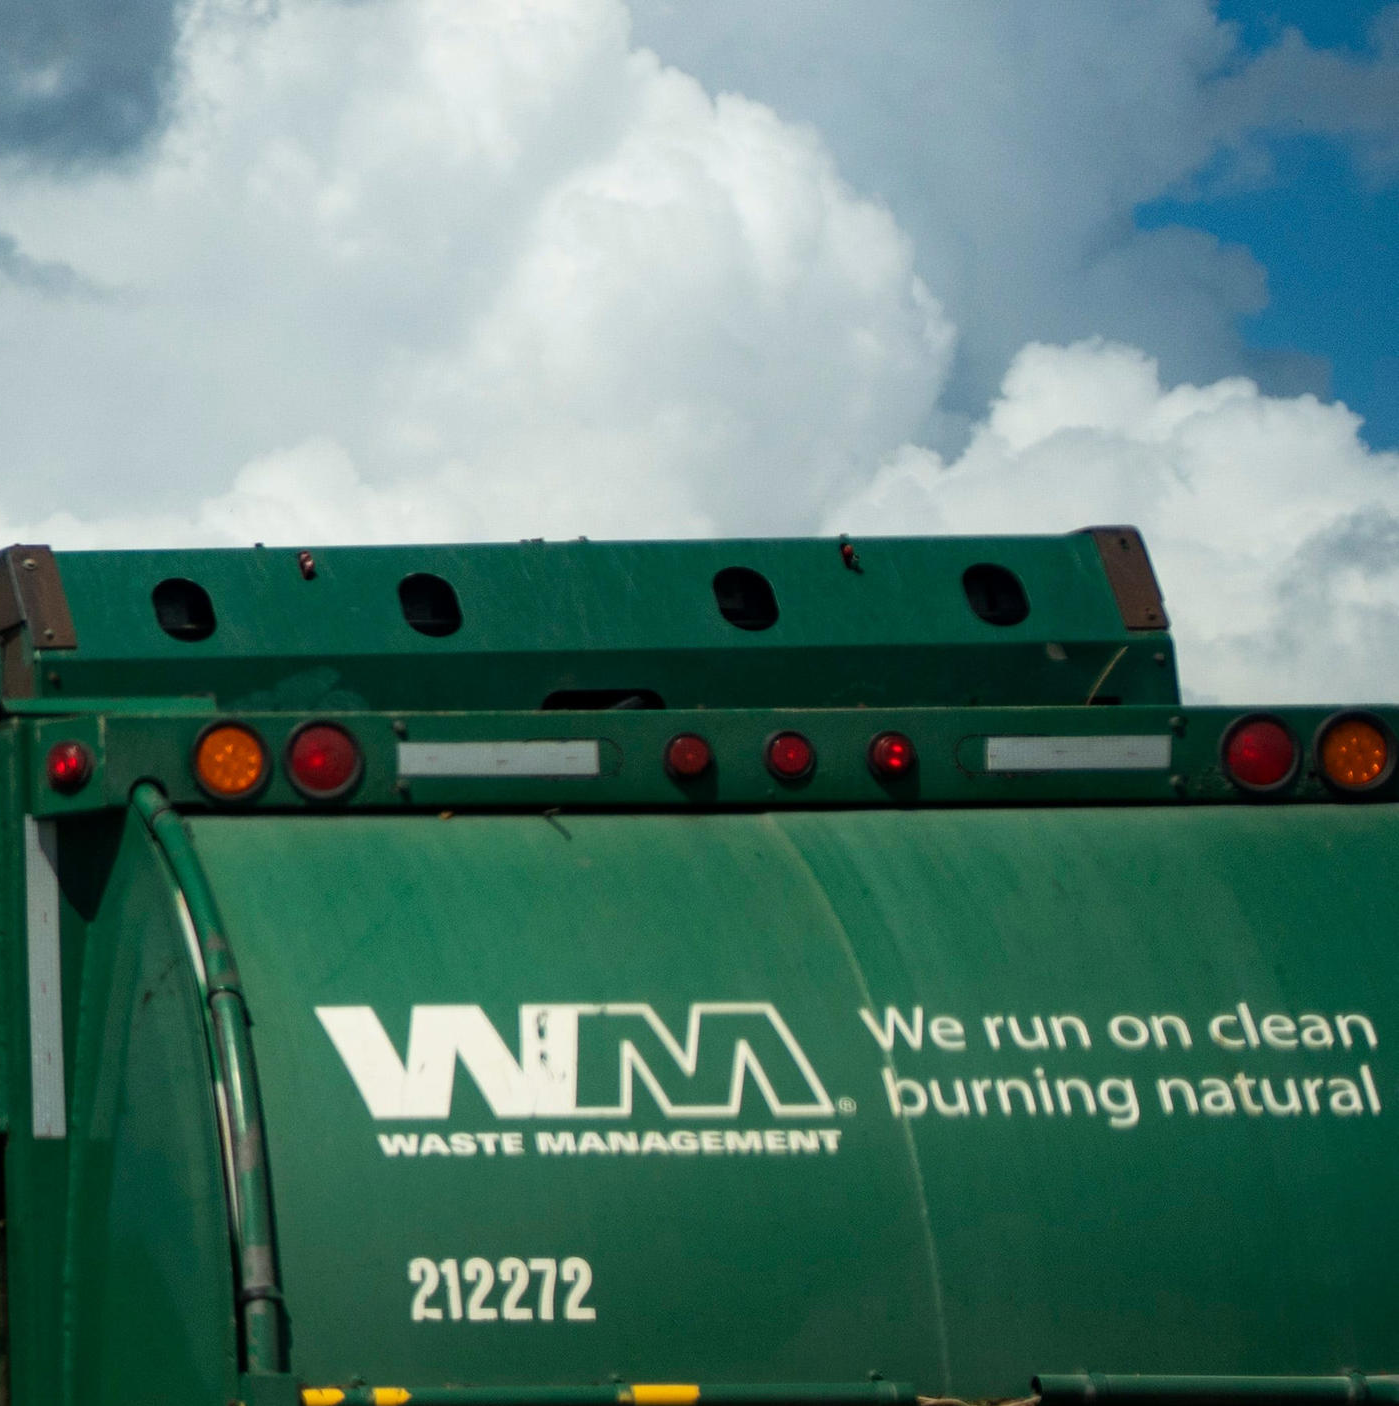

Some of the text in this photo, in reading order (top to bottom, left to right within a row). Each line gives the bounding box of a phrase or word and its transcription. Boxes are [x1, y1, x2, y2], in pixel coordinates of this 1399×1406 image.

[861, 1002, 1379, 1053] We run on clean
[881, 1064, 1383, 1127] burning natural
[376, 1128, 843, 1157] WASTE MANAGEMENT
[407, 1256, 597, 1321] 212272
